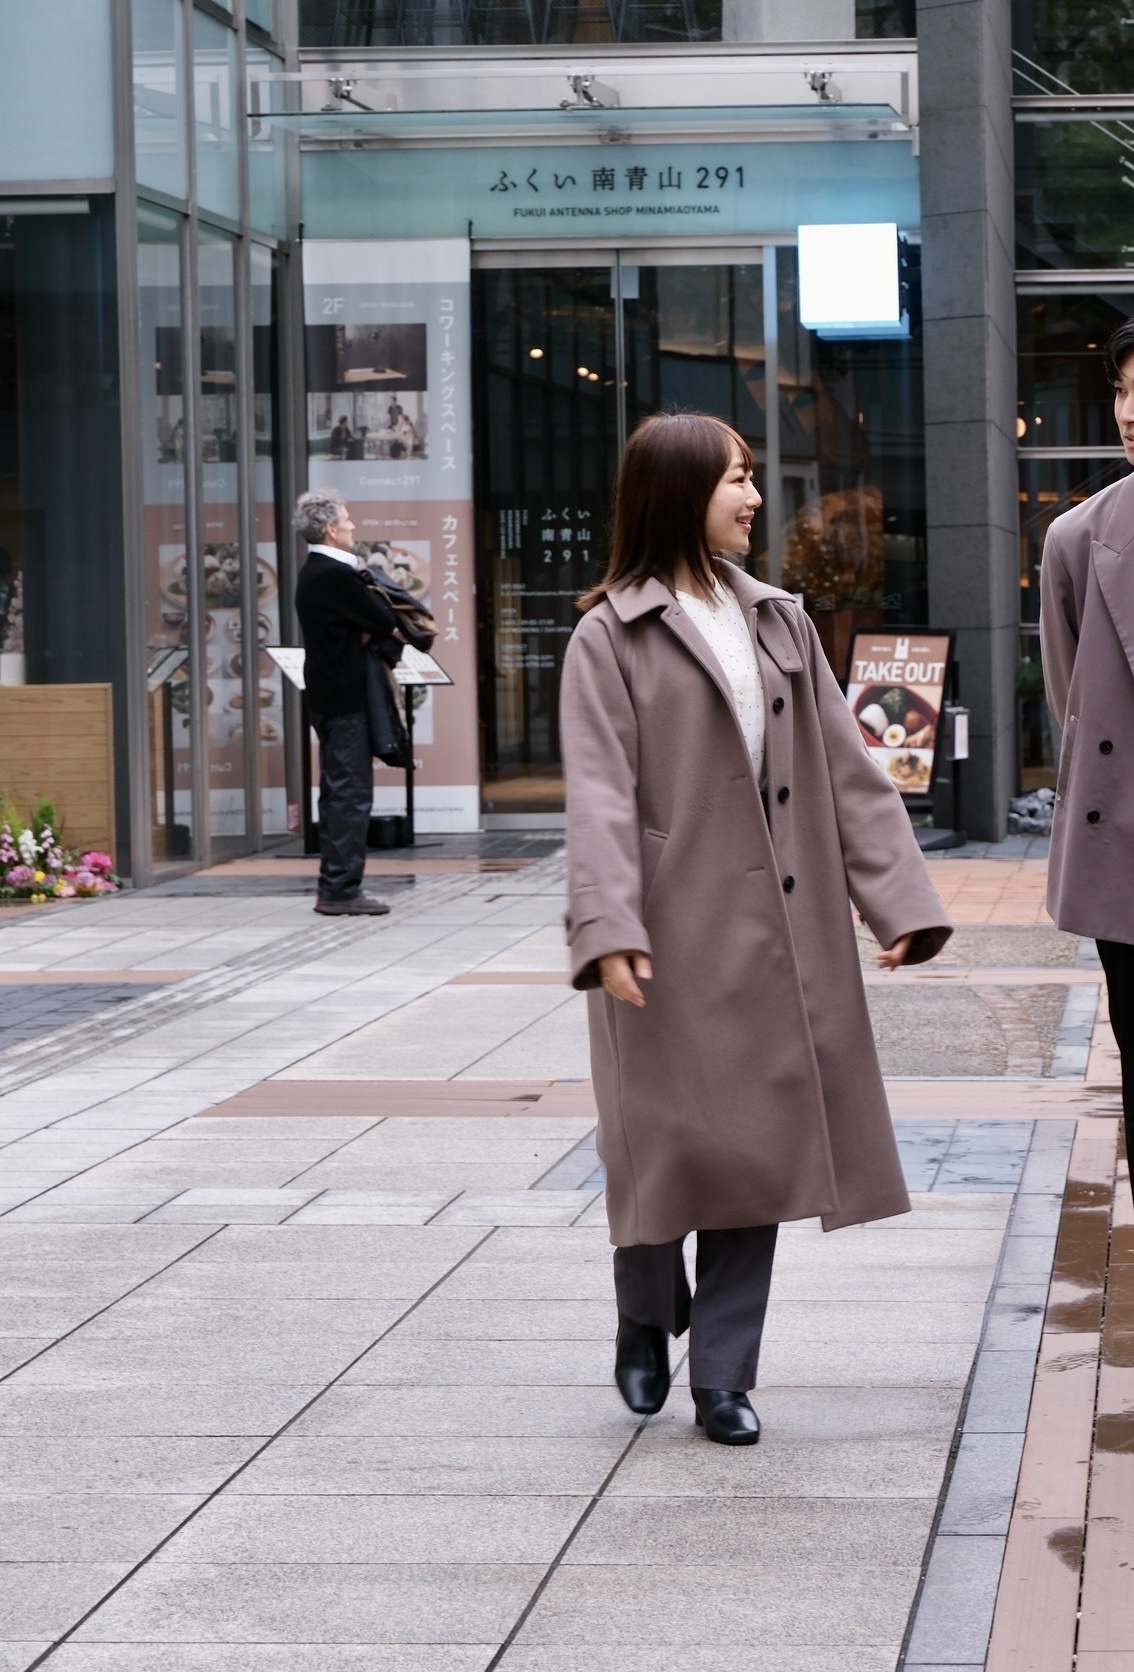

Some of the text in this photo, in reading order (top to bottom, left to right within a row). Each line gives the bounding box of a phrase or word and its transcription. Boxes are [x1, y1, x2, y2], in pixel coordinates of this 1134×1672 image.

[490, 165, 745, 193] ふくい 南青山 291
[513, 204, 720, 218] FUKUI ANTENNA SHOP MINAMIAOYAMA
[322, 298, 345, 315] 2F
[439, 299, 457, 471] コワーキングスペース
[541, 507, 591, 520] ふくい
[543, 549, 589, 562] 291
[442, 514, 460, 641] カフェスペース
[854, 660, 945, 684] TAKE OUT
